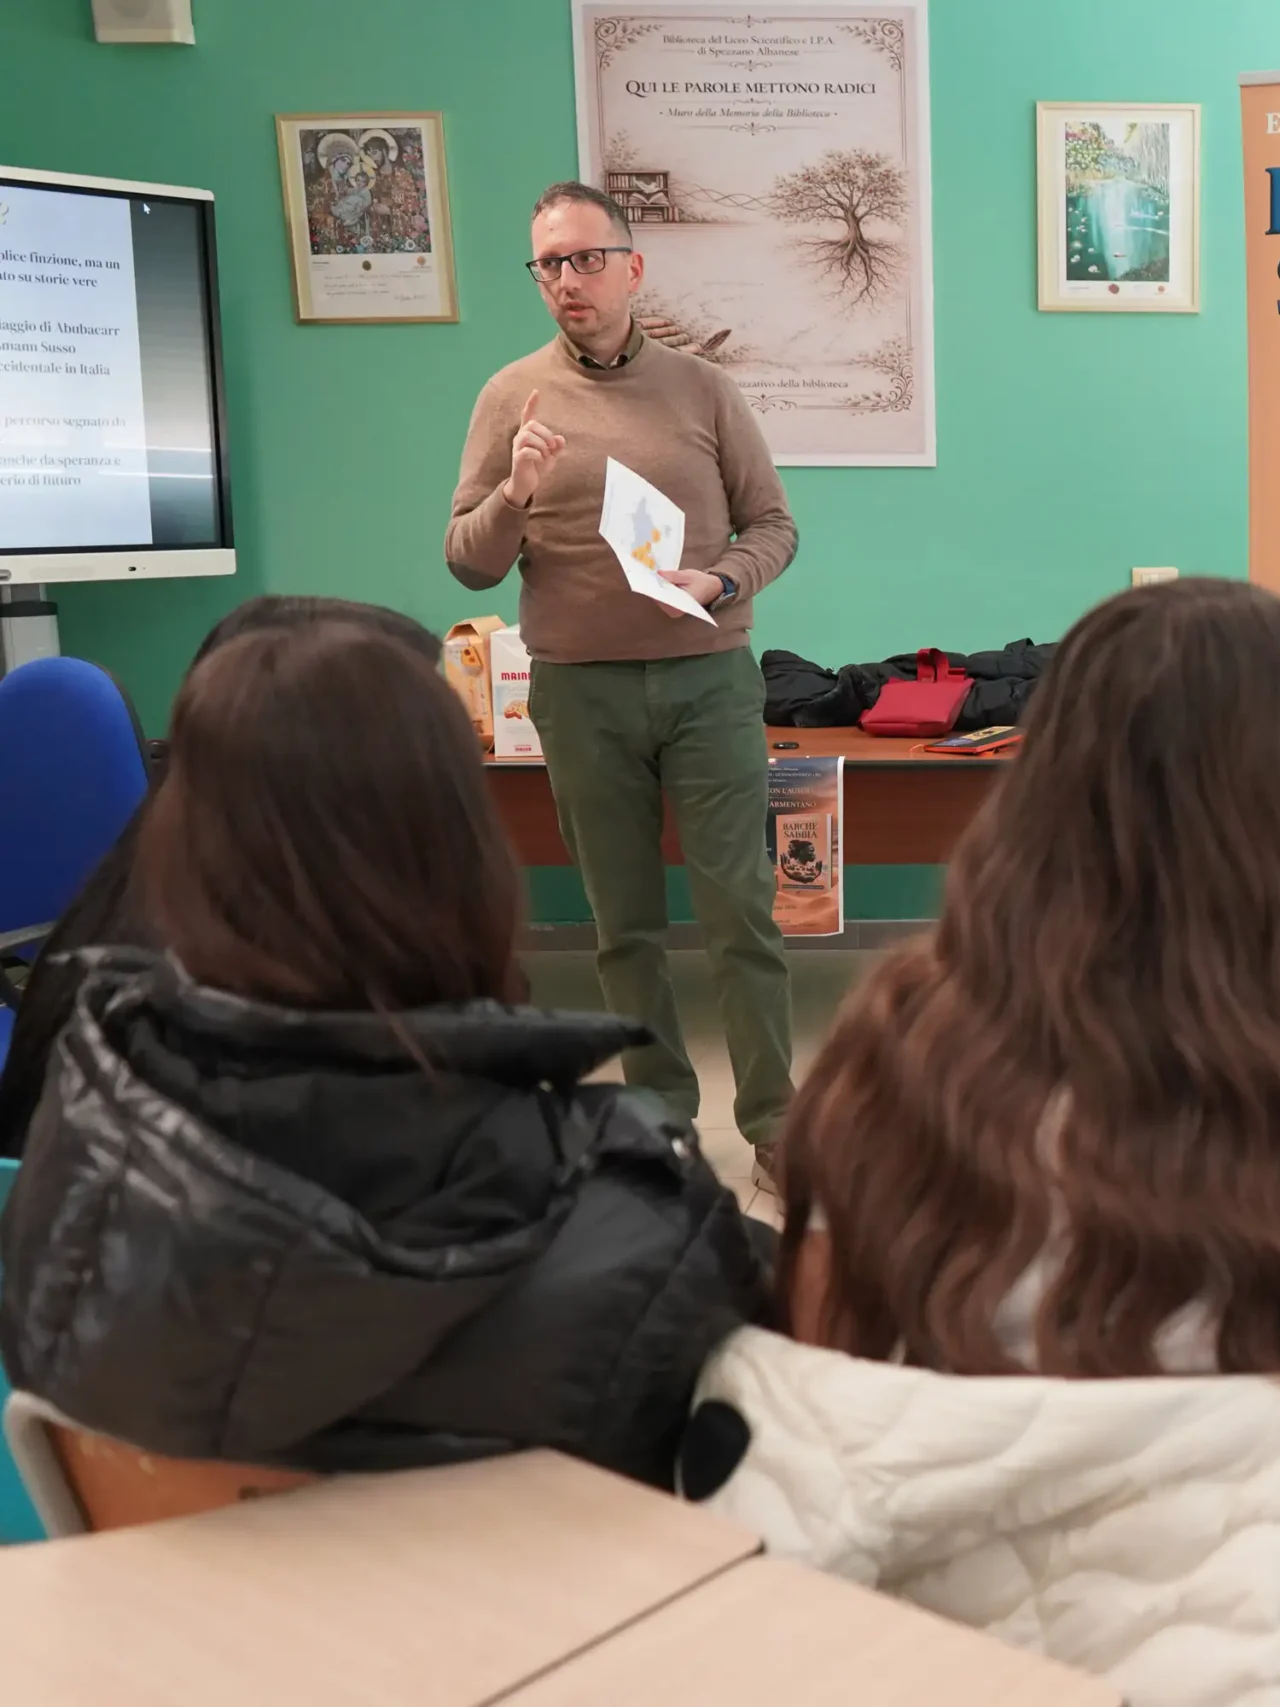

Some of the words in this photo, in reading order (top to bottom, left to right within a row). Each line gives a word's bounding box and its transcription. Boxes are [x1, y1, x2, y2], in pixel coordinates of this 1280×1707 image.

[663, 35, 706, 45] Biblioteca
[709, 36, 723, 45] del
[725, 36, 749, 45] Liceo
[751, 36, 800, 45] Scientifico
[697, 47, 707, 56] di
[709, 47, 753, 58] Spezzano
[757, 47, 799, 57] Albanese
[625, 79, 658, 98] QUI
[662, 81, 680, 94] LE
[685, 81, 742, 94] PAROLE
[745, 81, 820, 95] METTONO
[824, 82, 877, 95] RADICI
[667, 107, 693, 117] Muro
[695, 108, 717, 117] della
[719, 108, 760, 118] Memoria
[762, 108, 784, 118] della
[786, 108, 832, 118] Biblioteca
[30, 251, 83, 268] finzione,
[85, 258, 103, 269] ma
[105, 260, 121, 270] un
[18, 273, 32, 283] su
[35, 273, 69, 285] storie
[72, 277, 98, 288] vere
[39, 320, 52, 333] di
[56, 321, 121, 336] Abubacarr
[41, 340, 76, 354] Susso
[65, 362, 77, 374] in
[80, 363, 111, 376] Italia
[777, 379, 799, 388] della
[802, 379, 849, 389] biblioteca
[39, 453, 55, 466] da
[57, 454, 112, 469] speranza
[28, 473, 40, 486] di
[42, 474, 82, 486] futuro
[768, 801, 817, 809] ARMENTANO
[783, 822, 818, 832] BARCHE
